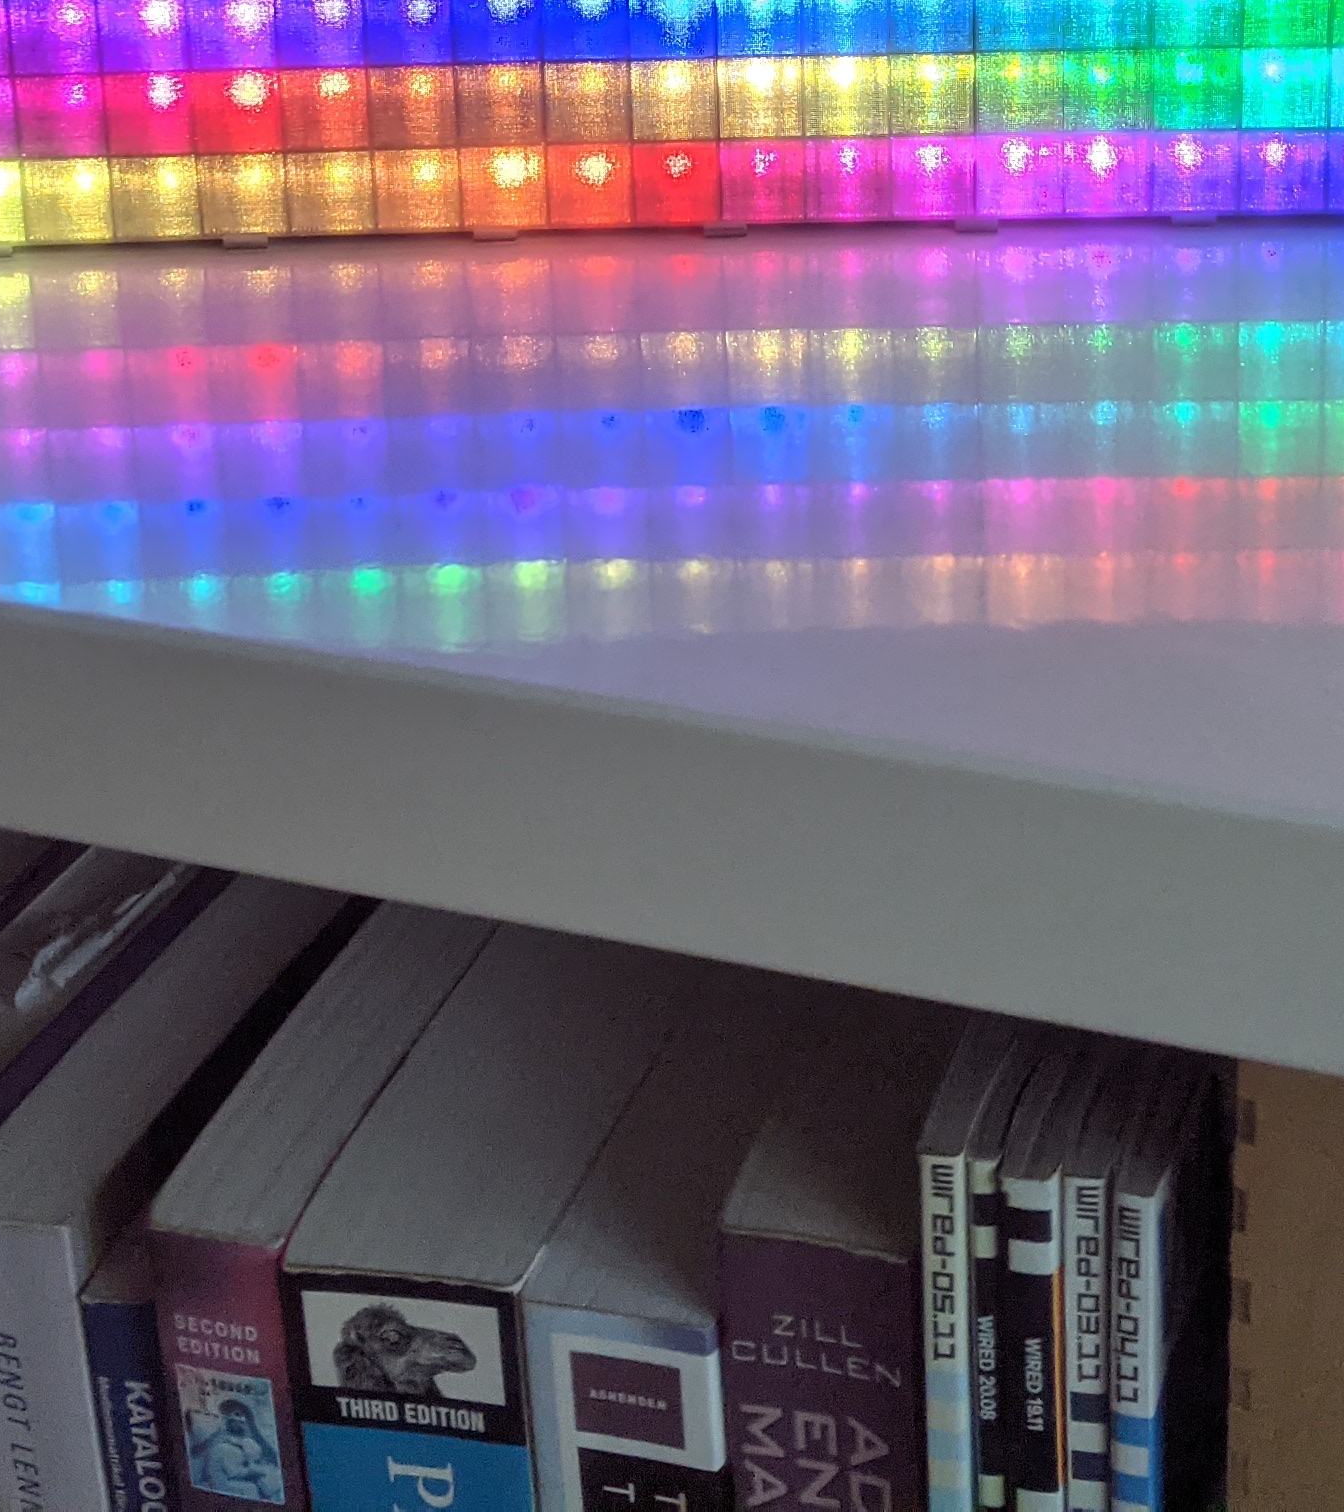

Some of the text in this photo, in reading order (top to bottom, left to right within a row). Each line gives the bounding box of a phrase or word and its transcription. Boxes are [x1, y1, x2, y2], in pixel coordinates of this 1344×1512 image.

[175, 1314, 258, 1342] SECOND
[177, 1336, 260, 1364] EDITION
[772, 1314, 864, 1348] ZILL
[732, 1340, 902, 1388] CULLEN
[977, 1314, 997, 1422] WIRED 20.08
[1025, 1337, 1043, 1393] WIRED
[336, 1396, 399, 1422] THIRD
[404, 1402, 486, 1434] EDITION
[739, 1402, 788, 1508] MA
[793, 1409, 842, 1510] EN
[387, 1455, 455, 1512] P
